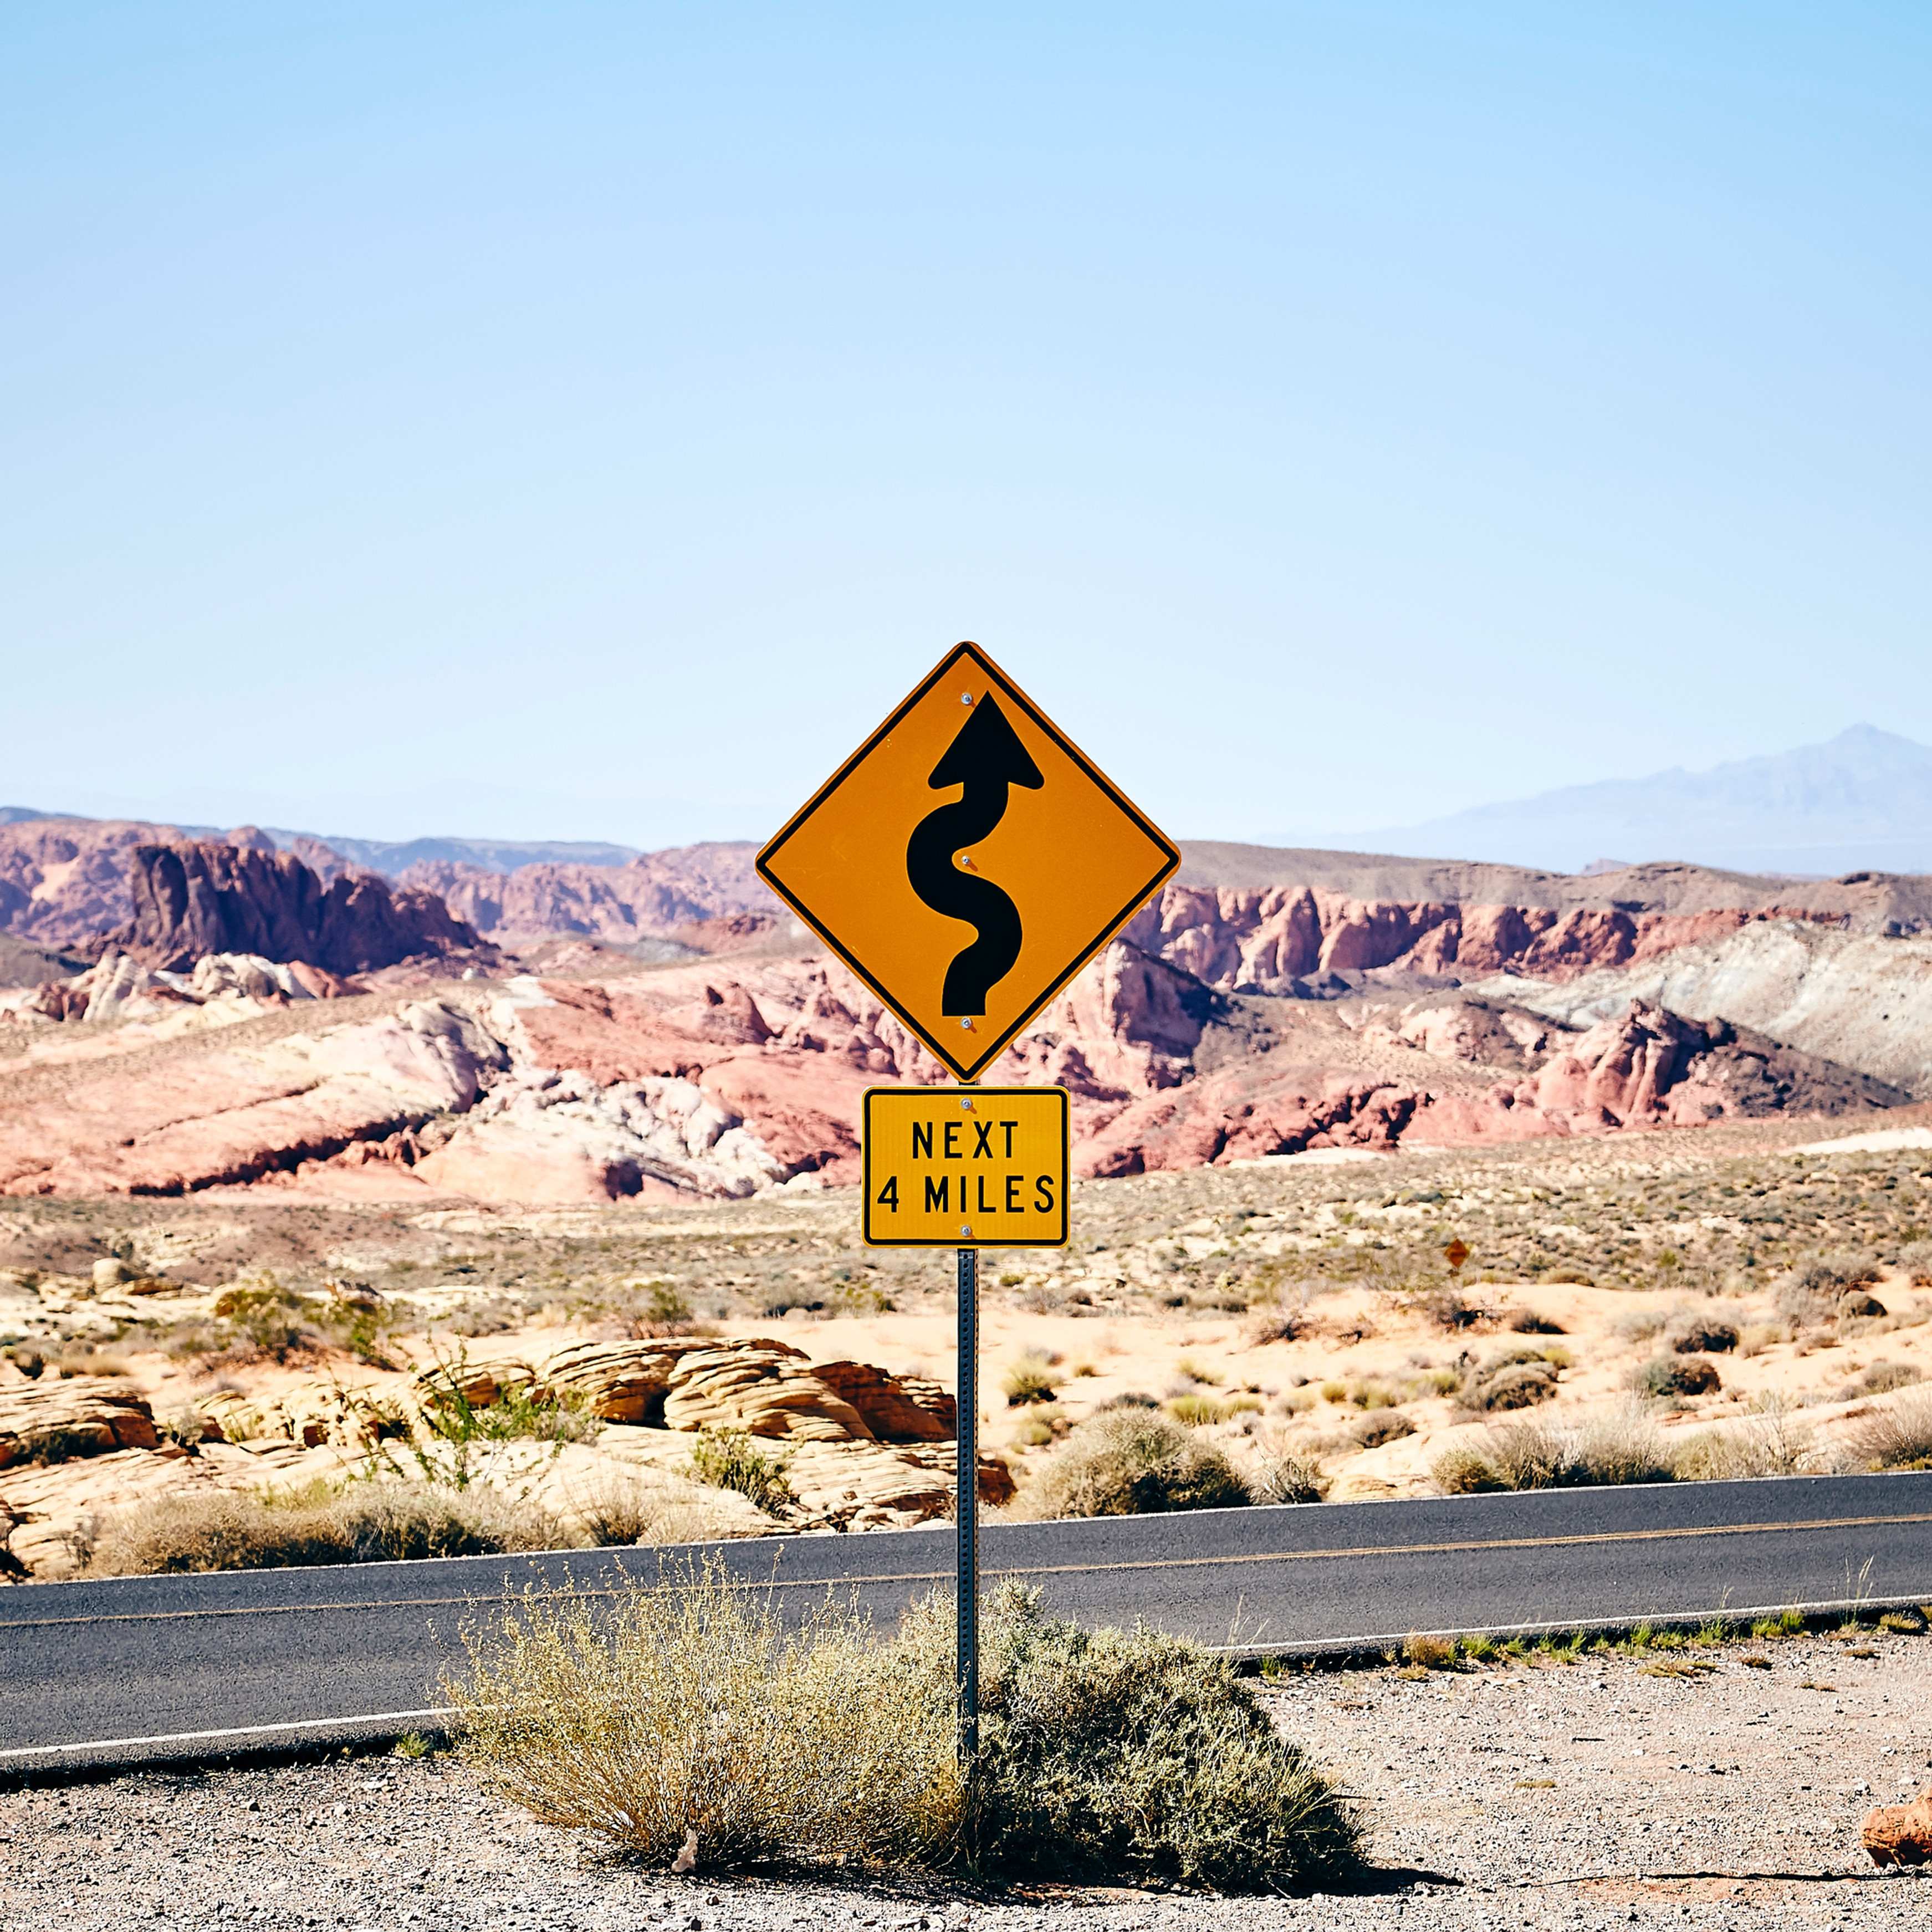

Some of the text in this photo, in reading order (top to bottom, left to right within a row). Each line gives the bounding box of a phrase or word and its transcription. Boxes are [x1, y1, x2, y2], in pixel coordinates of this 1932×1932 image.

[912, 1121, 1019, 1159] NEXT
[877, 1174, 1055, 1213] 4 MILES
